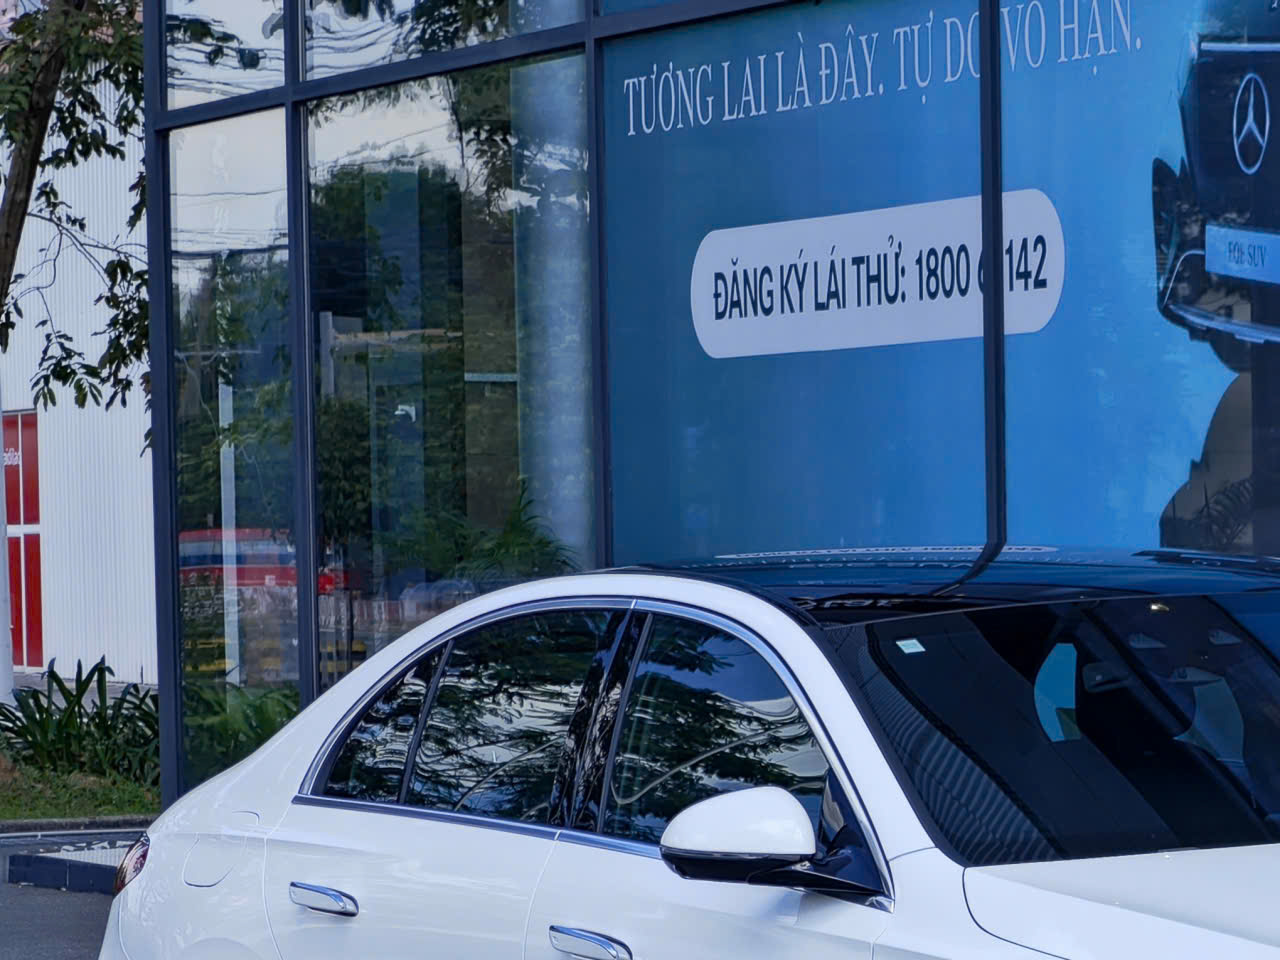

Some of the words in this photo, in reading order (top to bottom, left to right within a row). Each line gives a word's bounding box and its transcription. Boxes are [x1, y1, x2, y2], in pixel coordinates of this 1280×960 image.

[623, 61, 714, 137] TƯƠNG
[721, 54, 768, 121] LAI
[775, 31, 813, 113] LÀ
[818, 23, 884, 105] ĐÂY.
[893, 9, 934, 105] TỰ
[712, 257, 774, 321] ĐĂNG
[779, 248, 809, 315] KÝ
[813, 245, 847, 312] LÁI
[851, 234, 907, 308] THỬ:
[915, 243, 971, 302] 1800
